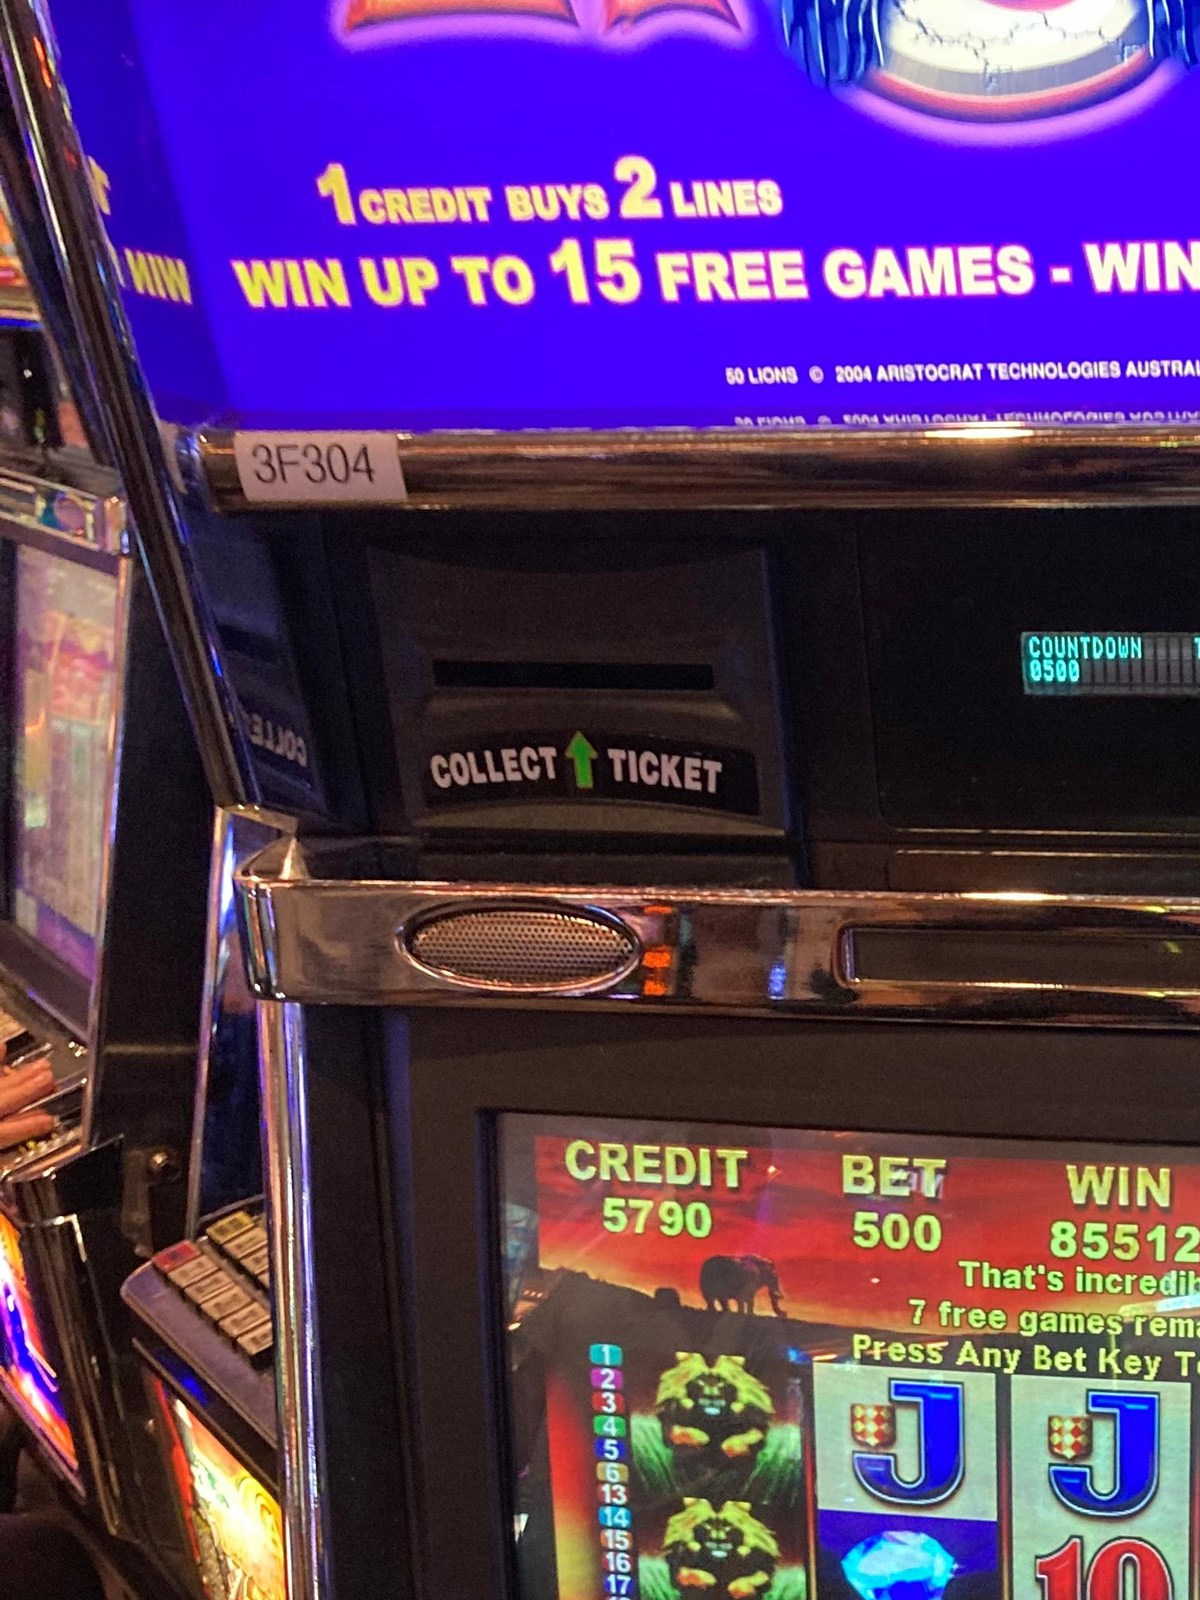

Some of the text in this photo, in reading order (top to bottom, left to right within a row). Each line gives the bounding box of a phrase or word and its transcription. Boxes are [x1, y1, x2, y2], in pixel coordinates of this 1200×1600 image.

[317, 155, 783, 225] 1 CREDIT BUYS 2 LINES
[232, 256, 347, 308] WIN
[362, 255, 438, 306] UP
[451, 255, 535, 304] TO
[550, 239, 641, 305] 15
[656, 250, 809, 302] FREE
[823, 245, 1034, 299] GAMES
[725, 366, 745, 385] 50
[748, 366, 798, 385] LIONS
[835, 364, 872, 383] 2004
[877, 363, 983, 382] ARISTOCRAT
[987, 360, 1121, 381] TECHNOLOGIES
[252, 444, 376, 485] 3F304
[1029, 636, 1142, 660] COUNTDOWN
[1030, 660, 1080, 682] 0500
[430, 747, 722, 793] COLLECT TICKET
[565, 1140, 1172, 1208] CREDIT BET WIN
[602, 1197, 712, 1238] 5790
[853, 1212, 942, 1251] 500
[959, 1261, 1064, 1292] That's
[909, 1299, 925, 1325] 7
[939, 1300, 1007, 1330] free
[1020, 1308, 1122, 1341] games
[601, 1345, 610, 1365] 1
[853, 1334, 943, 1364] Press
[955, 1342, 1021, 1372] Any
[1034, 1345, 1086, 1373] Bet
[1098, 1349, 1161, 1381] Key
[601, 1392, 616, 1413] 3
[604, 1439, 619, 1460] 5
[852, 1378, 964, 1506] J
[1049, 1389, 1160, 1518] J
[602, 1484, 627, 1505] 13
[605, 1552, 631, 1572] 16
[607, 1574, 632, 1594] 17
